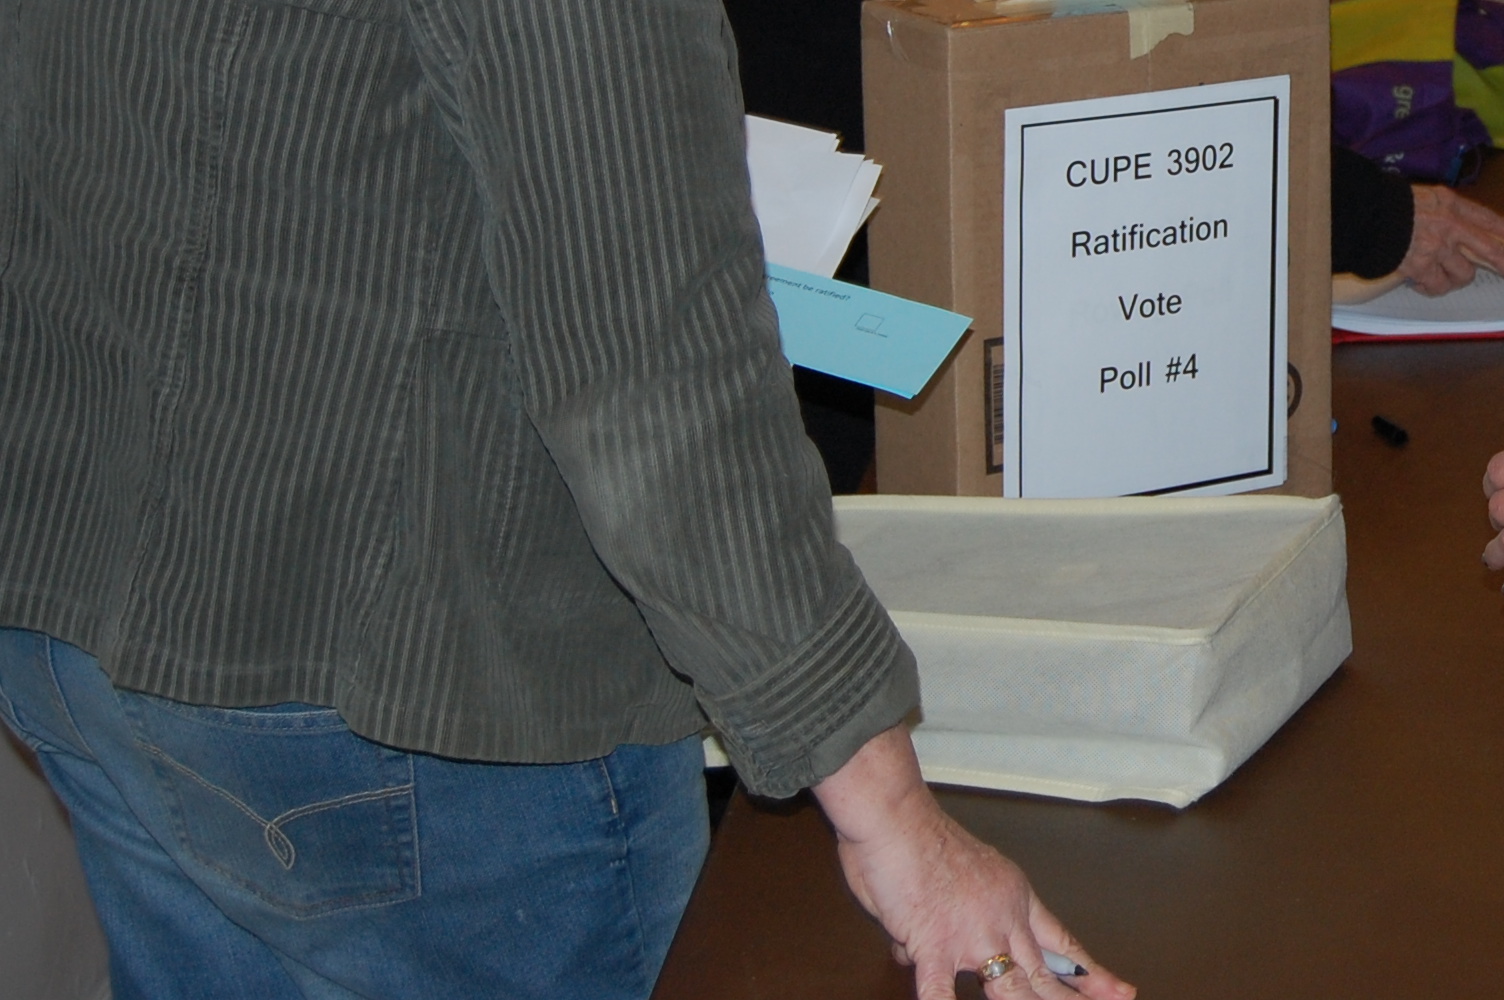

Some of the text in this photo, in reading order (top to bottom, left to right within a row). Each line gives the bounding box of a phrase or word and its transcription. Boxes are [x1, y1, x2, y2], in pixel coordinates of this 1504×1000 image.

[1066, 142, 1235, 188] CUPE 3902
[1071, 216, 1229, 258] Ratification
[802, 283, 814, 292] be
[815, 288, 852, 301] ratified?
[1118, 292, 1183, 321] Vote
[1100, 353, 1199, 394] Poll #4
